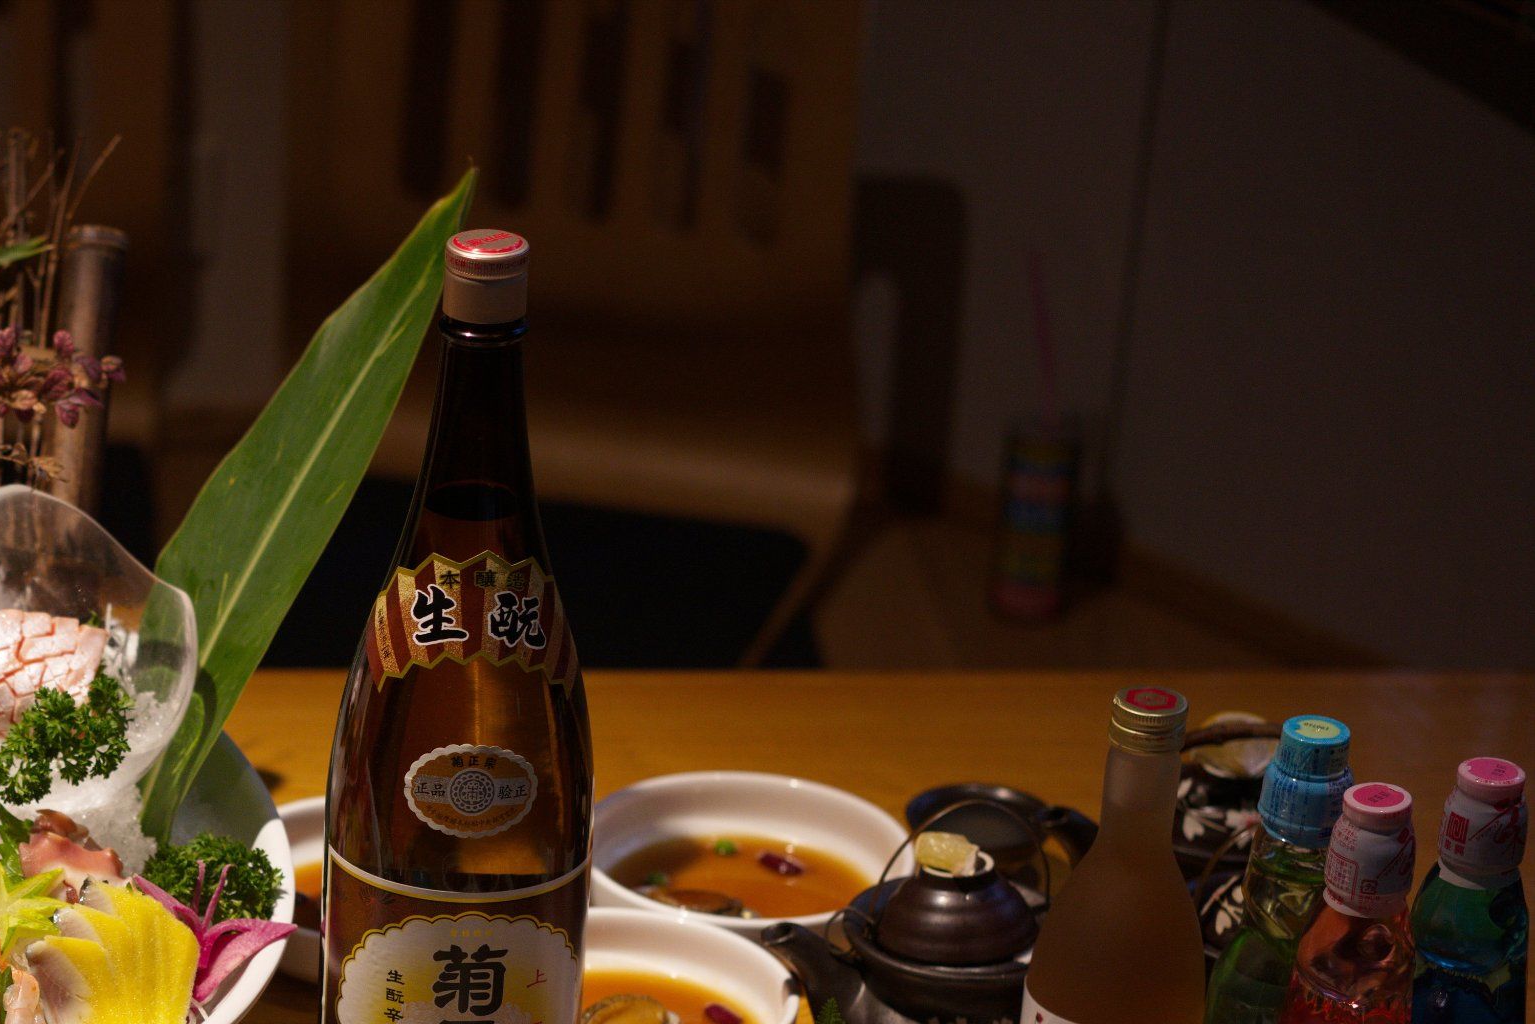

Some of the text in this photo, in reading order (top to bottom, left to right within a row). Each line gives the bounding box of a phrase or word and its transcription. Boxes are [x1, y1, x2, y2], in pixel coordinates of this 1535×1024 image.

[412, 584, 546, 649] 生酛
[451, 755, 497, 769] 菊正宗
[414, 782, 445, 797] 正品
